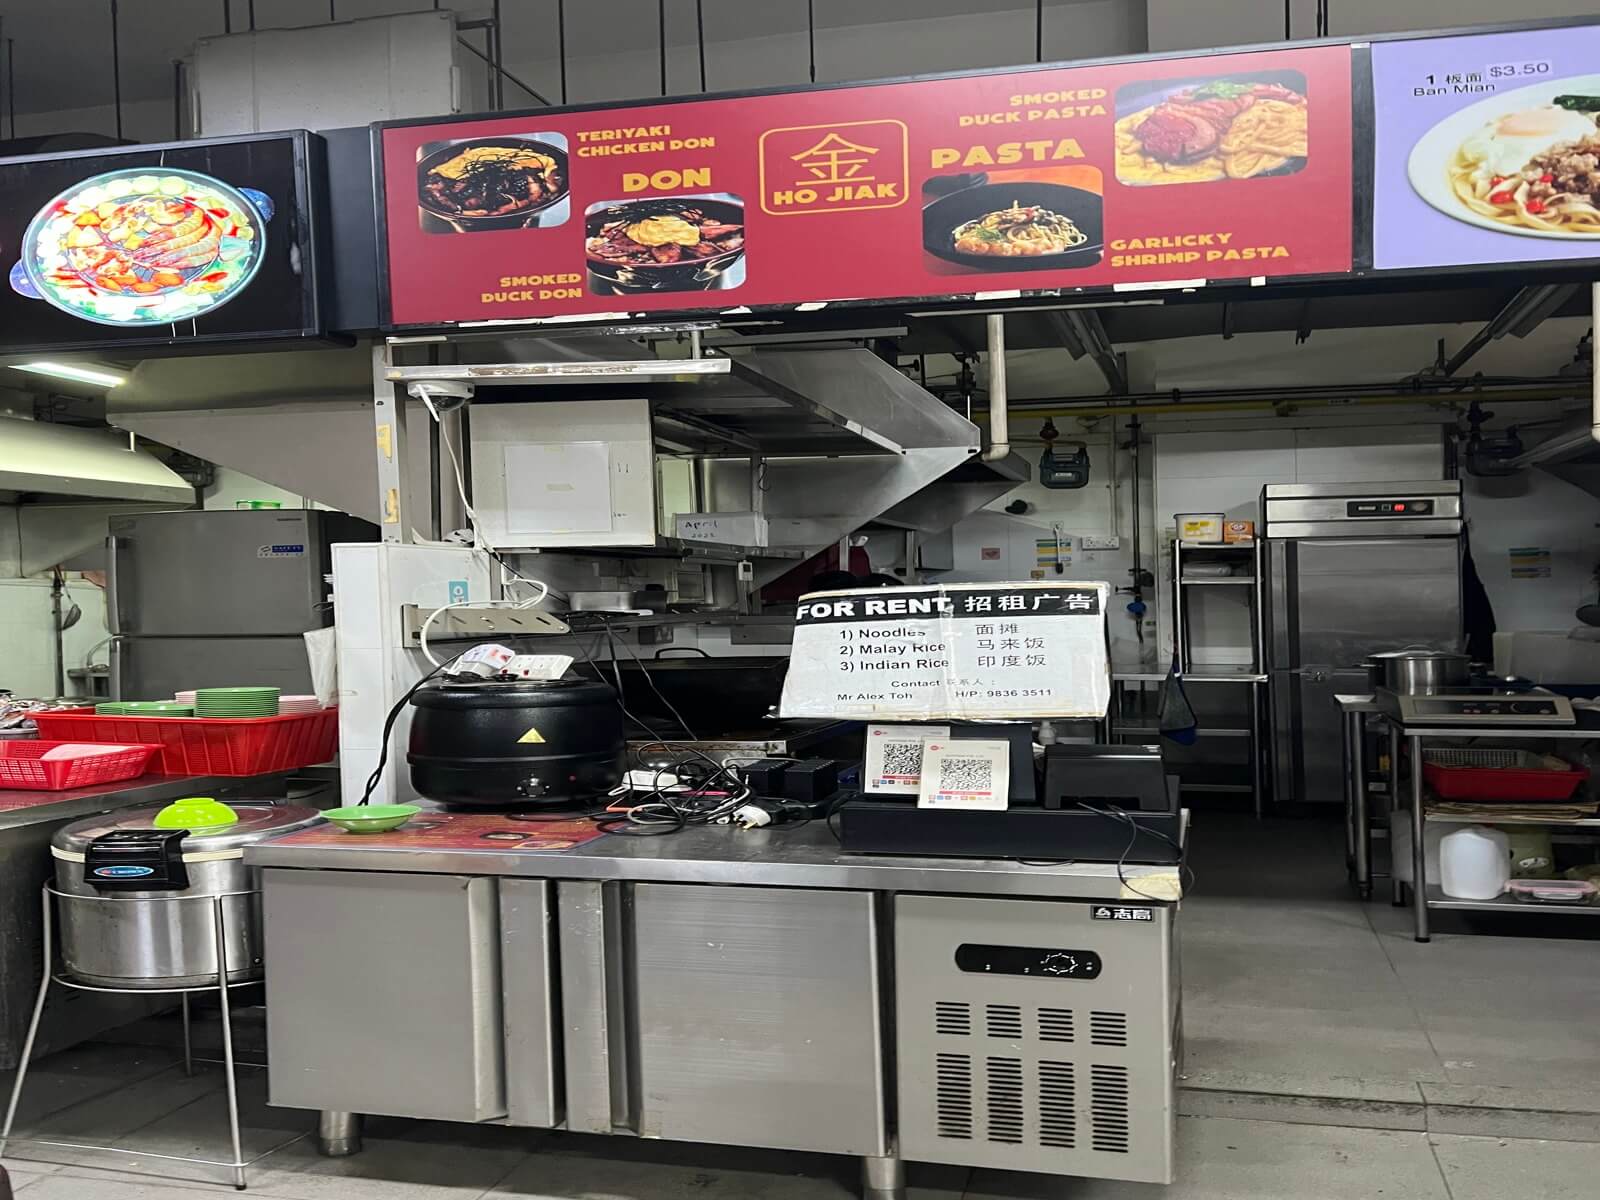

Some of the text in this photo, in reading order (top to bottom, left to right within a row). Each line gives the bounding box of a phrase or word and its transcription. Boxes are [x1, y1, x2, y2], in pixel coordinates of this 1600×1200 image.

[1426, 74, 1435, 85] 1
[1489, 62, 1549, 77] $3.50
[1009, 88, 1107, 107] SMOKED
[1413, 83, 1495, 97] Ban Mian
[959, 104, 1107, 127] DUCK PASTA
[576, 125, 671, 142] TERIYAKI
[577, 136, 716, 158] CHICKEN DON
[930, 138, 1086, 169] PASTA
[622, 167, 712, 192] DON
[773, 182, 898, 206] HO JIAK
[1110, 232, 1232, 251] GARLICKY
[1110, 246, 1290, 267] SHRIMP PASTA
[499, 273, 583, 288] SMOKED
[480, 287, 583, 303] DUCK DON
[796, 597, 951, 620] FOR RENT
[964, 593, 1094, 612] 招租广告
[839, 627, 926, 641] 1) Noodles
[975, 622, 1020, 635] 面摊
[839, 643, 946, 657] 2) Malay Rice
[976, 636, 1045, 650] 马来饭
[839, 658, 949, 673] 3) Indian Rice
[977, 654, 1047, 668] 印度饭
[891, 679, 941, 688] Contact
[837, 693, 853, 701] Mr
[889, 692, 913, 700] Toh
[955, 689, 1052, 698] H/P: 9836 3511
